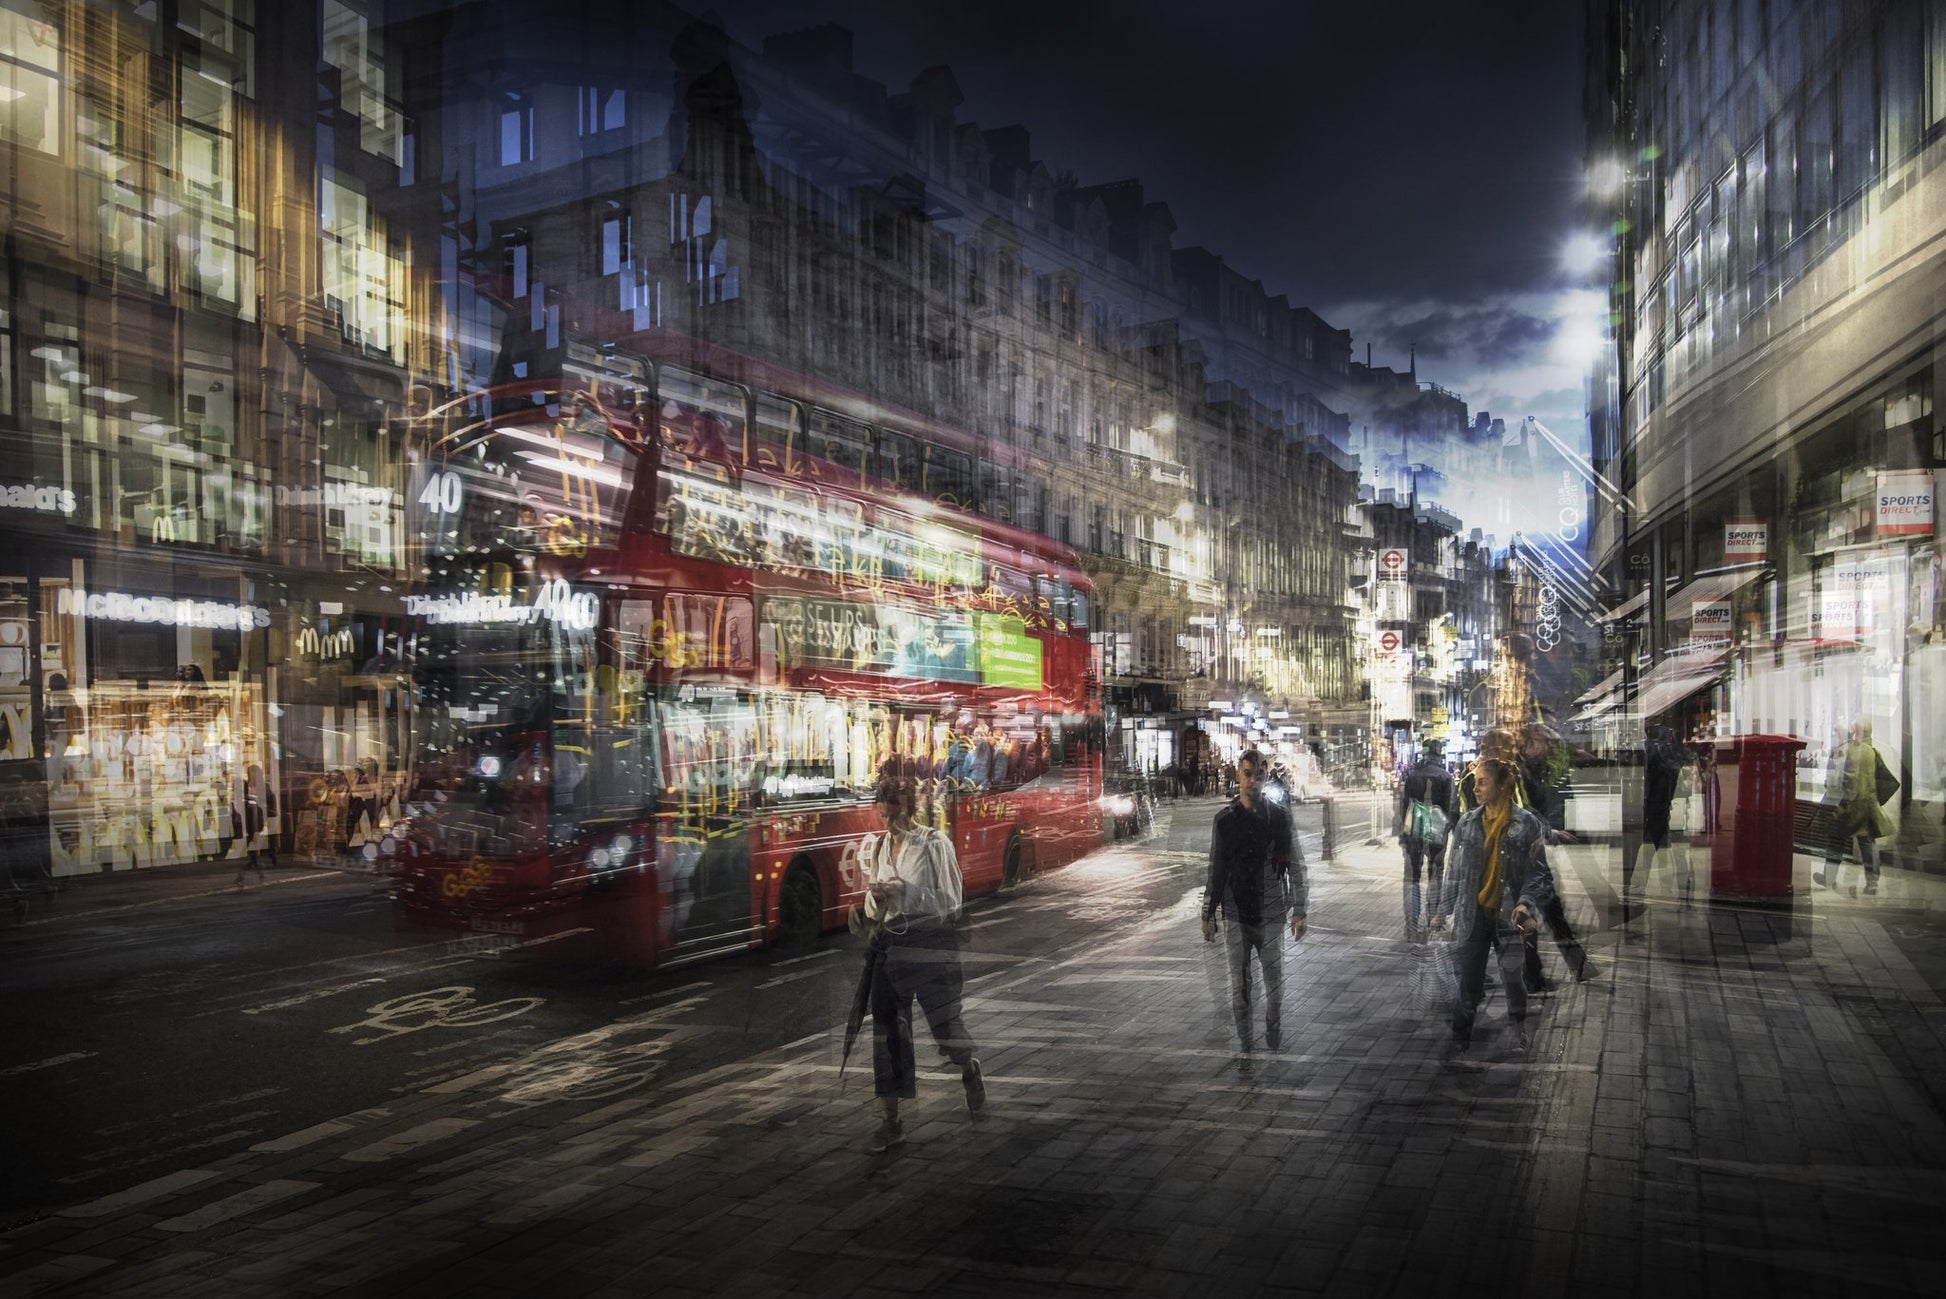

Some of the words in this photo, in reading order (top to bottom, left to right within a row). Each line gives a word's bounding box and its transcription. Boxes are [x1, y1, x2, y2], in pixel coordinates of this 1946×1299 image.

[418, 471, 463, 514] 40
[1880, 495, 1931, 506] SPORTS
[1727, 531, 1766, 540] SPORTS
[1694, 608, 1730, 617] SPORTS
